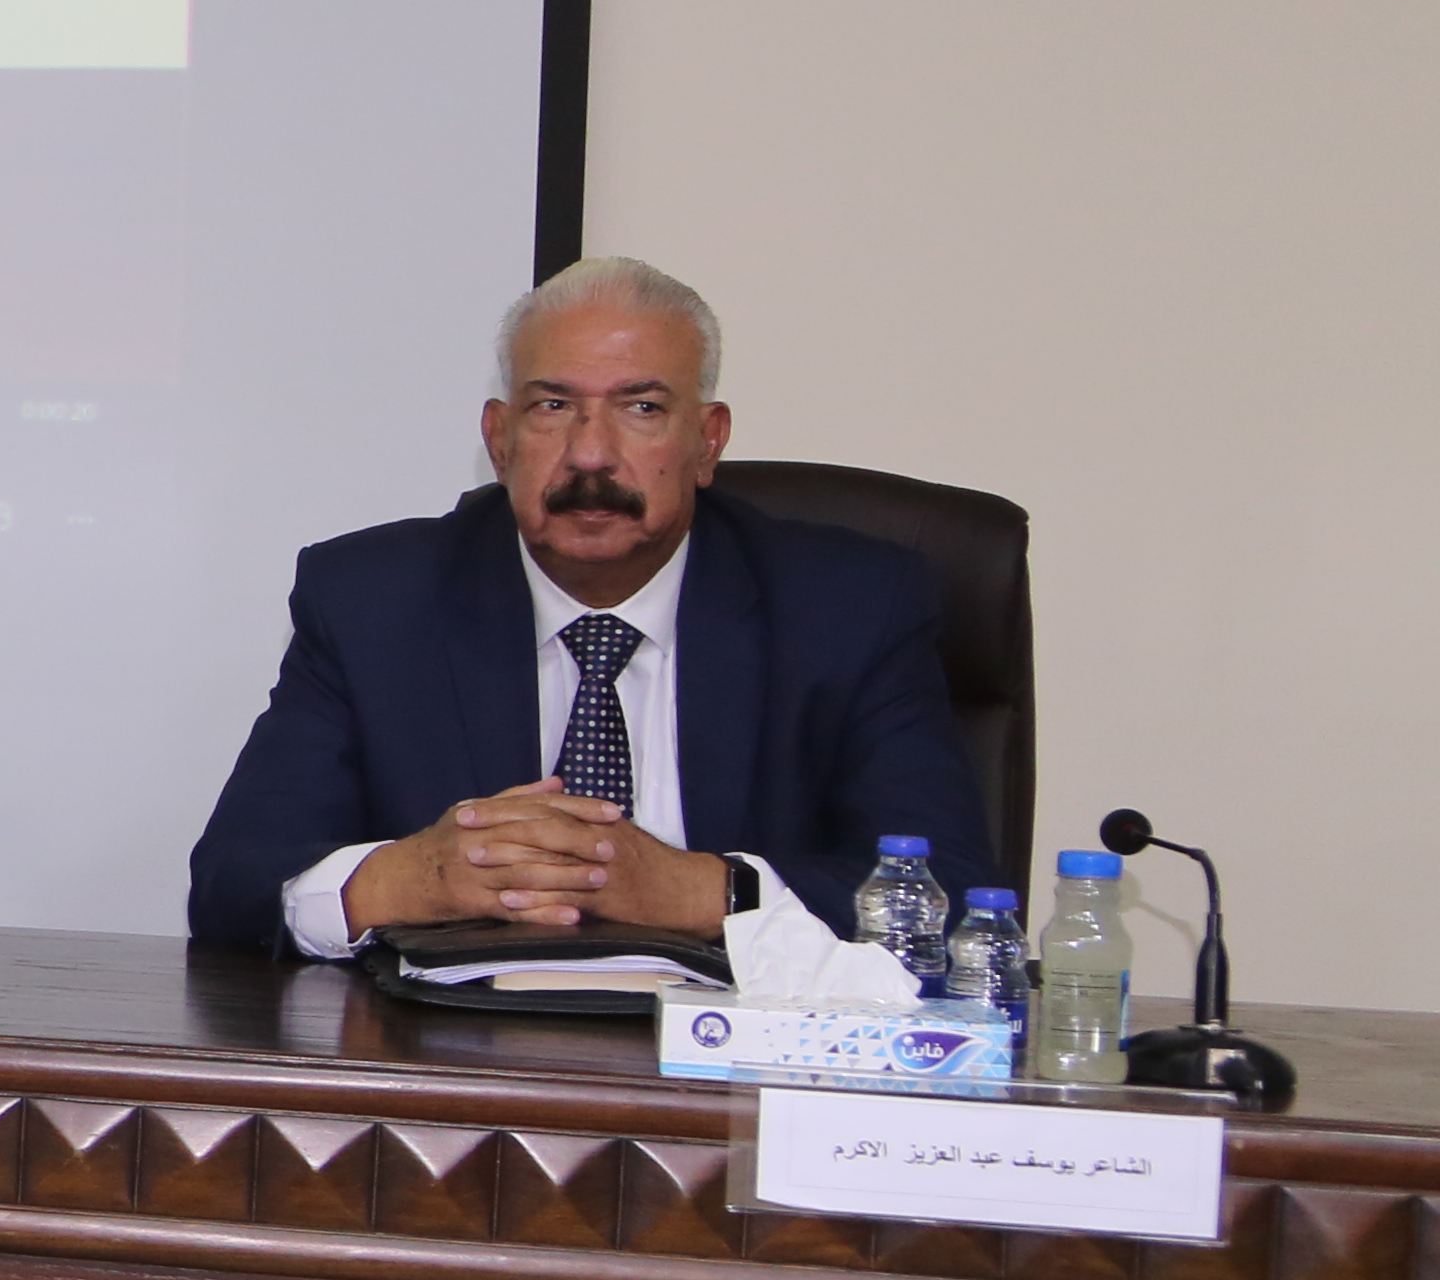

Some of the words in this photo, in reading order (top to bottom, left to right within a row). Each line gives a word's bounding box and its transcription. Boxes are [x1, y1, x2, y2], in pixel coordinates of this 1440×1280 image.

[901, 1035, 945, 1063] فاين
[832, 1140, 888, 1162] الاكرم
[903, 1143, 962, 1166] العزيز
[968, 1149, 1003, 1169] عبد
[1011, 1149, 1077, 1176] يوسف
[1082, 1155, 1153, 1177] الشاعر
